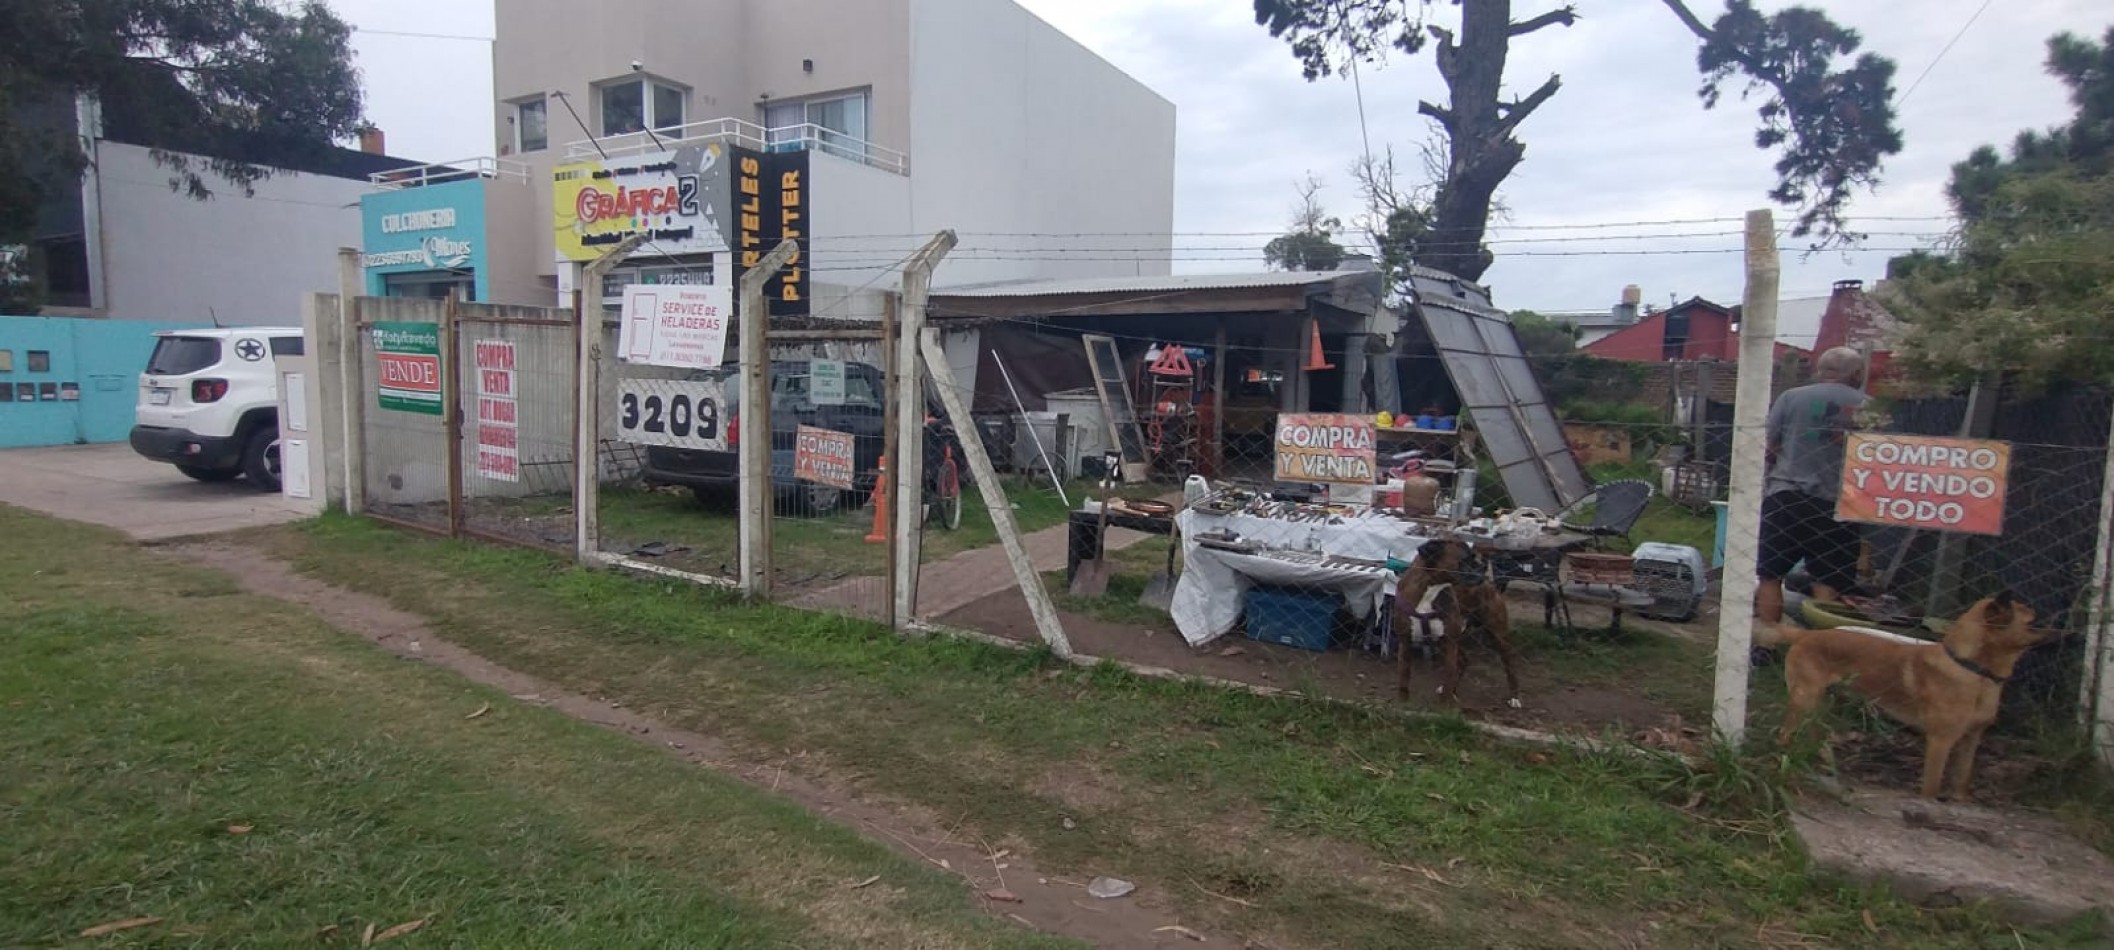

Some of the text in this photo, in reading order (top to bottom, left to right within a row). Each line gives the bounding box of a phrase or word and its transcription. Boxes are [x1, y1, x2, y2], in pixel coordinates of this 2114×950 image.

[740, 156, 760, 268] RTELES
[662, 302, 718, 316] SERVICE DE
[661, 317, 720, 331] HELADERAS
[476, 342, 515, 370] COMPRA
[379, 359, 435, 384] VENDE
[483, 370, 510, 395] VENTA
[621, 392, 719, 440] 3209
[798, 435, 853, 460] COMPRA
[1278, 423, 1371, 449] COMPRA
[1278, 452, 1371, 478] Y VENTA
[1855, 441, 1998, 471] COMPRO
[800, 457, 850, 482] Y VENTA
[1852, 468, 1997, 499] Y VENDO
[1874, 496, 1965, 525] TODO
